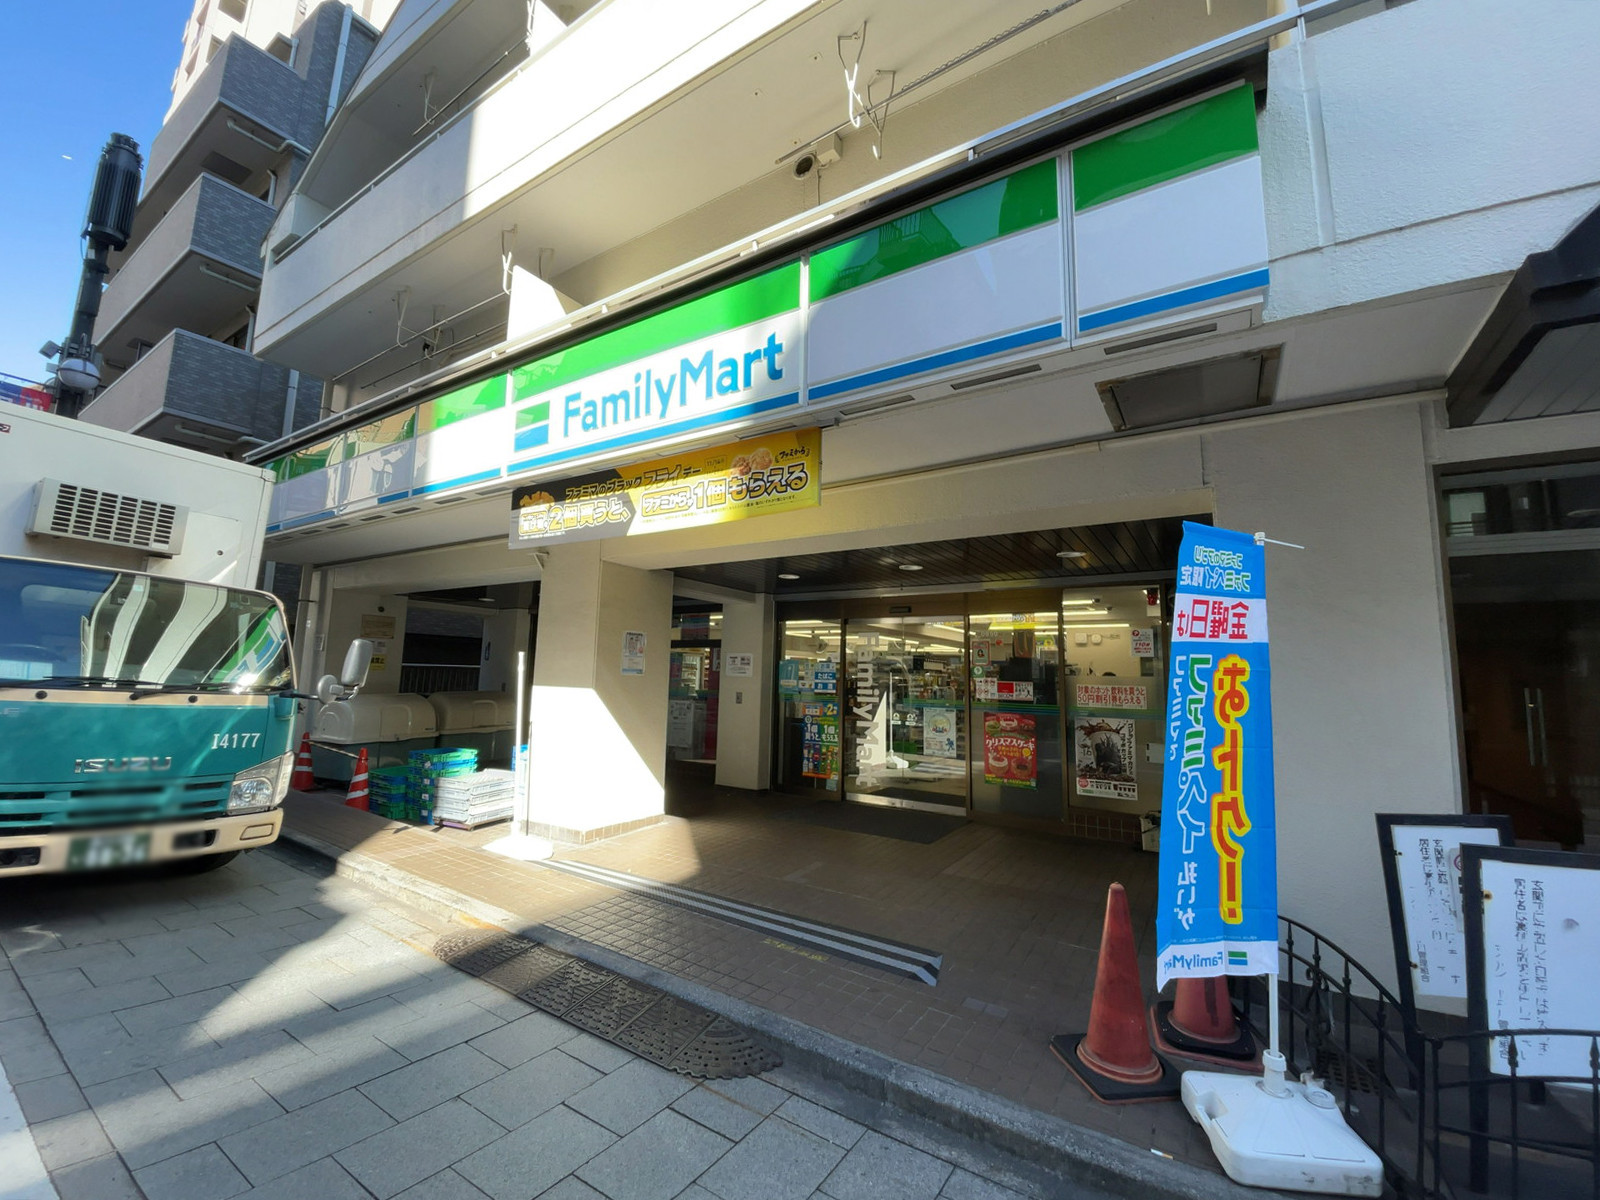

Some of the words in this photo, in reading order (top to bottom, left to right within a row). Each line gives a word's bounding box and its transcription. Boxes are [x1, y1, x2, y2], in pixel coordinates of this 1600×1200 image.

[563, 332, 783, 437] FamilyMart
[852, 632, 880, 787] FamilyMart
[74, 756, 172, 774] ISUZU
[211, 732, 262, 750] I4177
